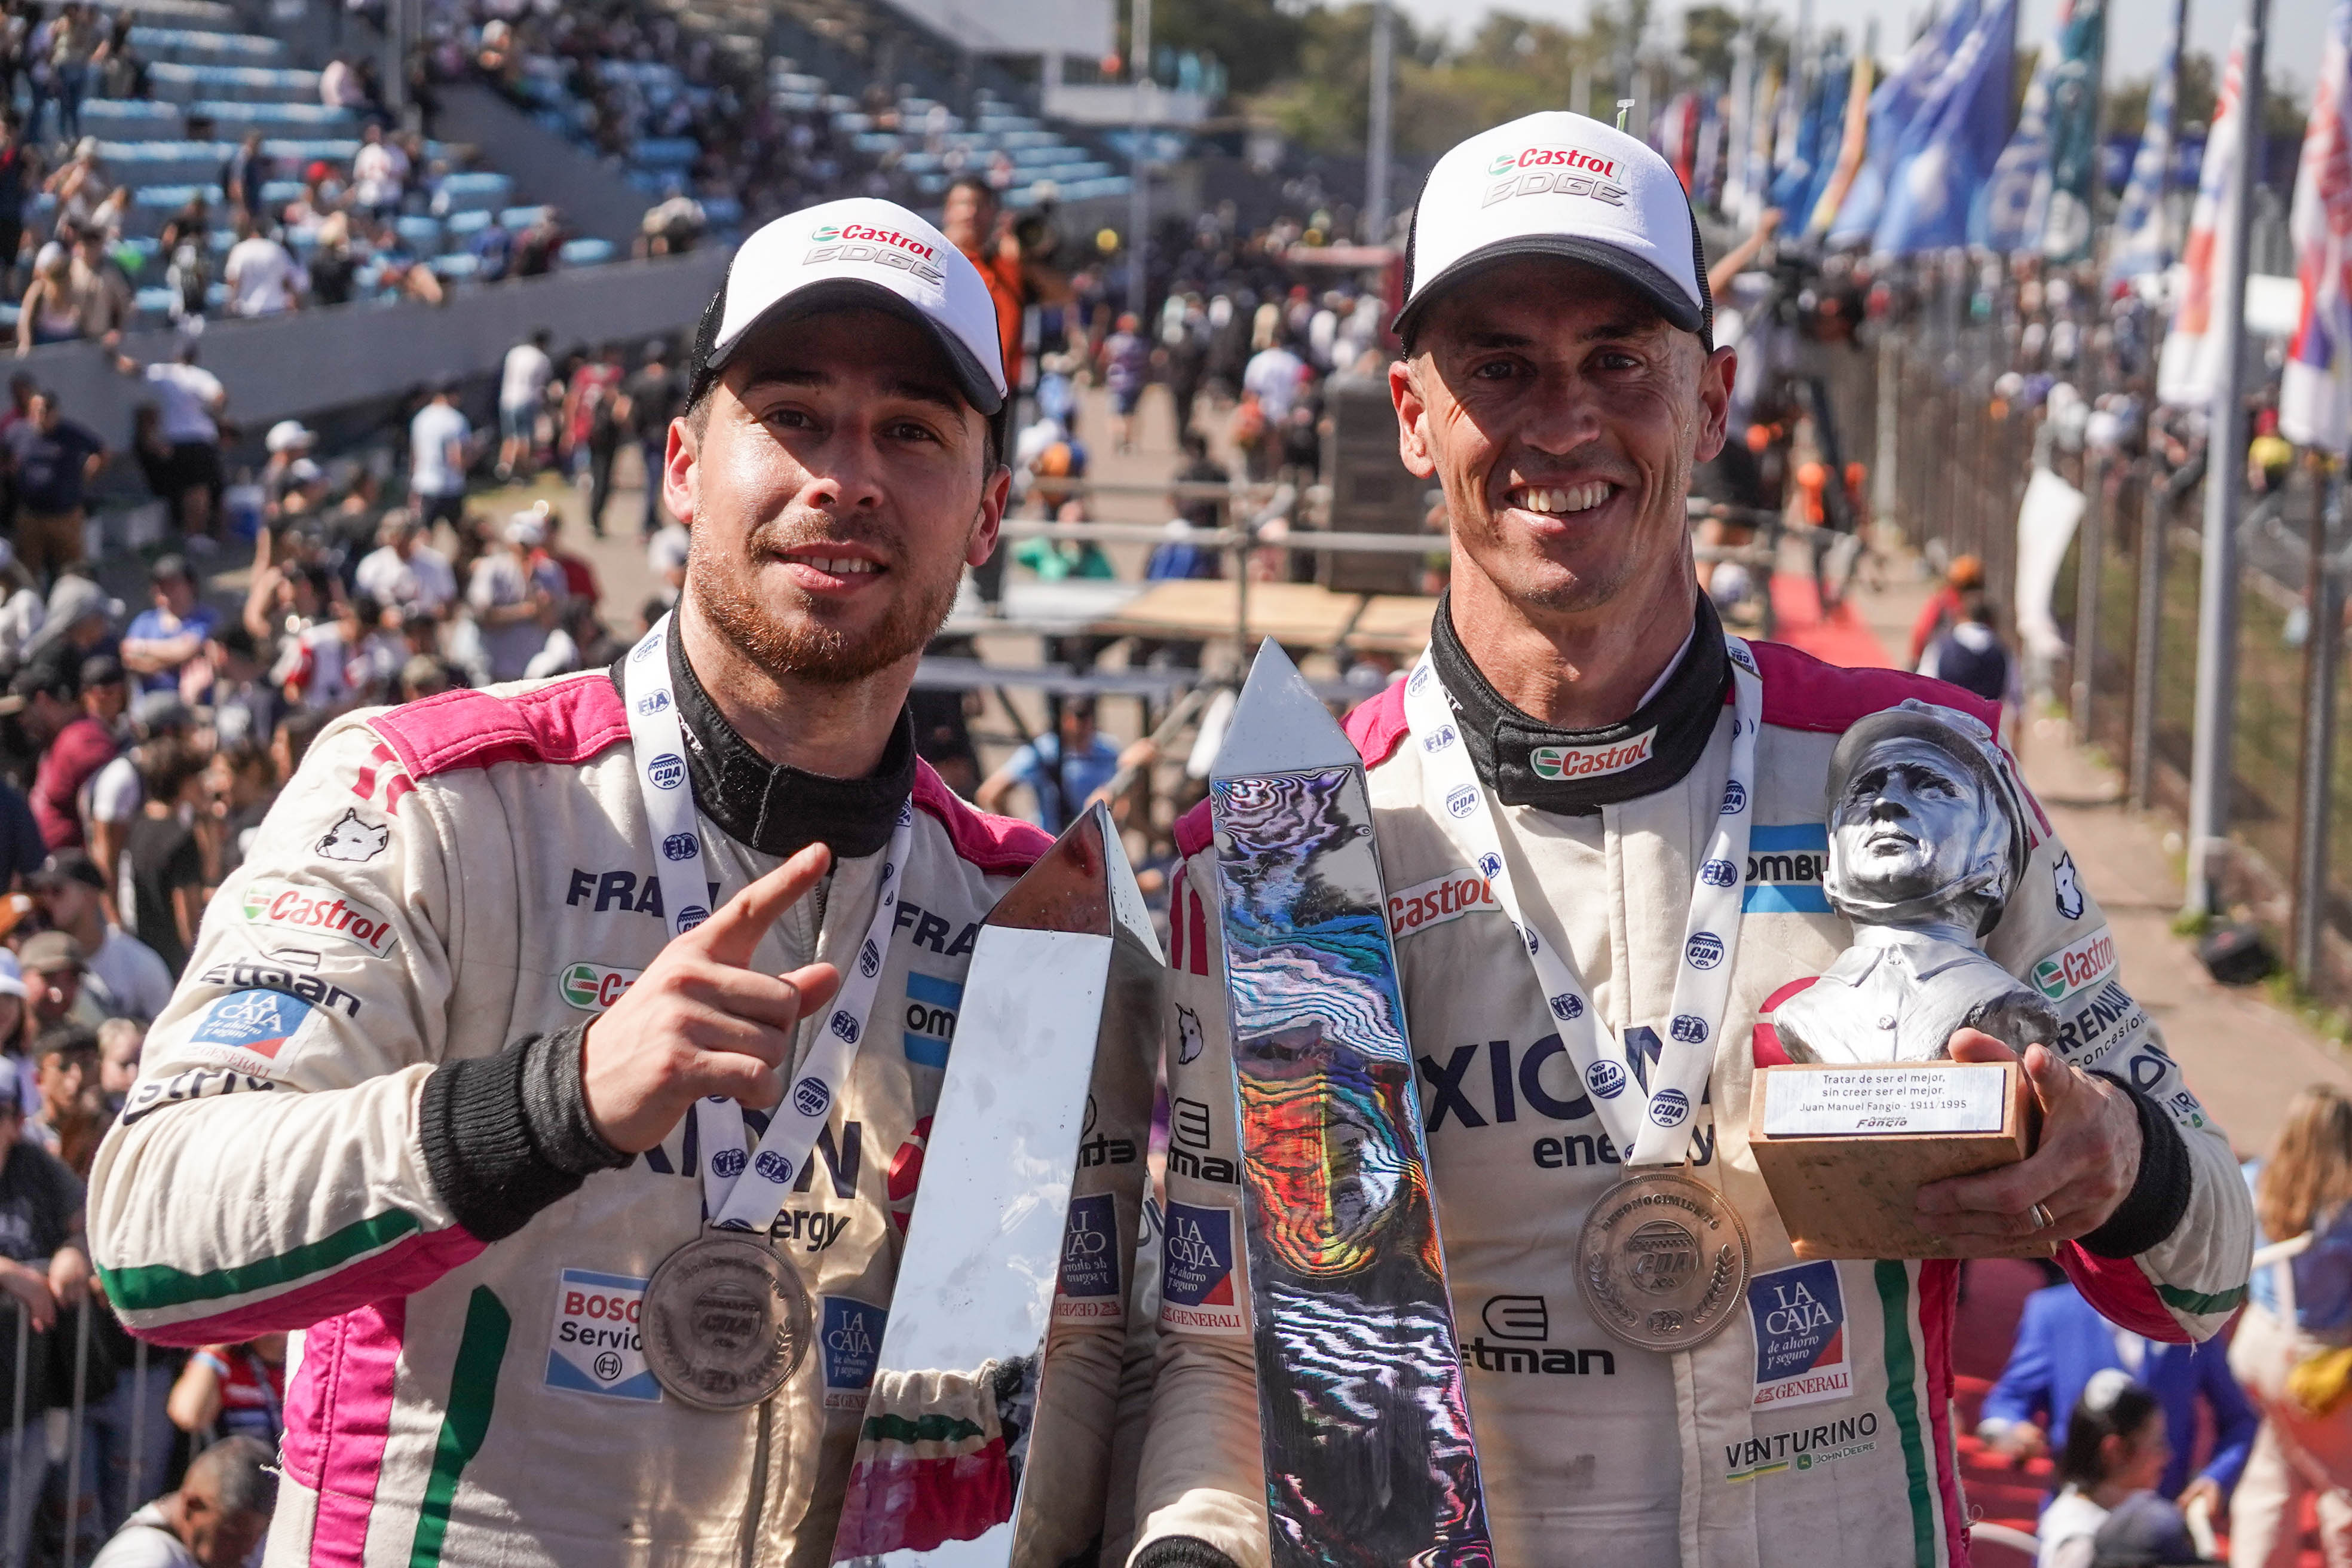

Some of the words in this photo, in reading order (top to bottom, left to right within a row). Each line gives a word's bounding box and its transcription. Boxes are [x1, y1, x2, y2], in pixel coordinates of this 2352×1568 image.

[1518, 148, 1614, 178] Castrol
[1481, 172, 1628, 209] EDGE
[842, 224, 935, 262] Castrol
[802, 244, 945, 286] EDGE
[1562, 735, 1647, 776] Castrol
[654, 766, 681, 781] CDA
[1453, 793, 1475, 813] CDA
[1724, 794, 1742, 806] DA
[1388, 875, 1494, 935] Castrol
[269, 890, 391, 950] Castrol
[1689, 946, 1719, 961] CDA
[240, 992, 278, 1012] LA
[218, 1004, 283, 1033] CAJA
[1590, 1066, 1618, 1088] CDA
[1823, 1075, 1855, 1084] Tratar
[1859, 1074, 1872, 1083] de
[1897, 1073, 1907, 1082] el
[1910, 1073, 1946, 1085] mejor,
[797, 1089, 825, 1110] CDA
[1823, 1088, 1839, 1097] sin
[1897, 1086, 1906, 1095] el
[1910, 1085, 1944, 1098] mejor.
[1653, 1104, 1684, 1119] CDA
[1800, 1103, 1824, 1111] Juan
[1827, 1102, 1864, 1111] Manuel
[1867, 1102, 1900, 1113] Fangio
[1910, 1100, 1967, 1110] 1911/1995
[771, 1207, 852, 1252] ergy
[1176, 1217, 1205, 1244] LA
[1169, 1237, 1221, 1270] CAJA
[1169, 1263, 1177, 1275] de
[1177, 1267, 1206, 1282] ahorro
[1172, 1278, 1198, 1292] seguro
[564, 1291, 642, 1325] BOSC
[1773, 1281, 1816, 1310] LA
[841, 1310, 864, 1331] LA
[1172, 1310, 1242, 1328] GENERALI
[1766, 1302, 1833, 1336] CAJA
[559, 1321, 644, 1352] Servic
[828, 1330, 875, 1357] CAJA
[1768, 1340, 1779, 1354] de
[1783, 1335, 1819, 1351] ahorro
[1766, 1356, 1774, 1370] y
[1776, 1349, 1809, 1366] seguro
[1775, 1372, 1849, 1399] GENERALI
[1726, 1412, 1878, 1468] VENTURINO
